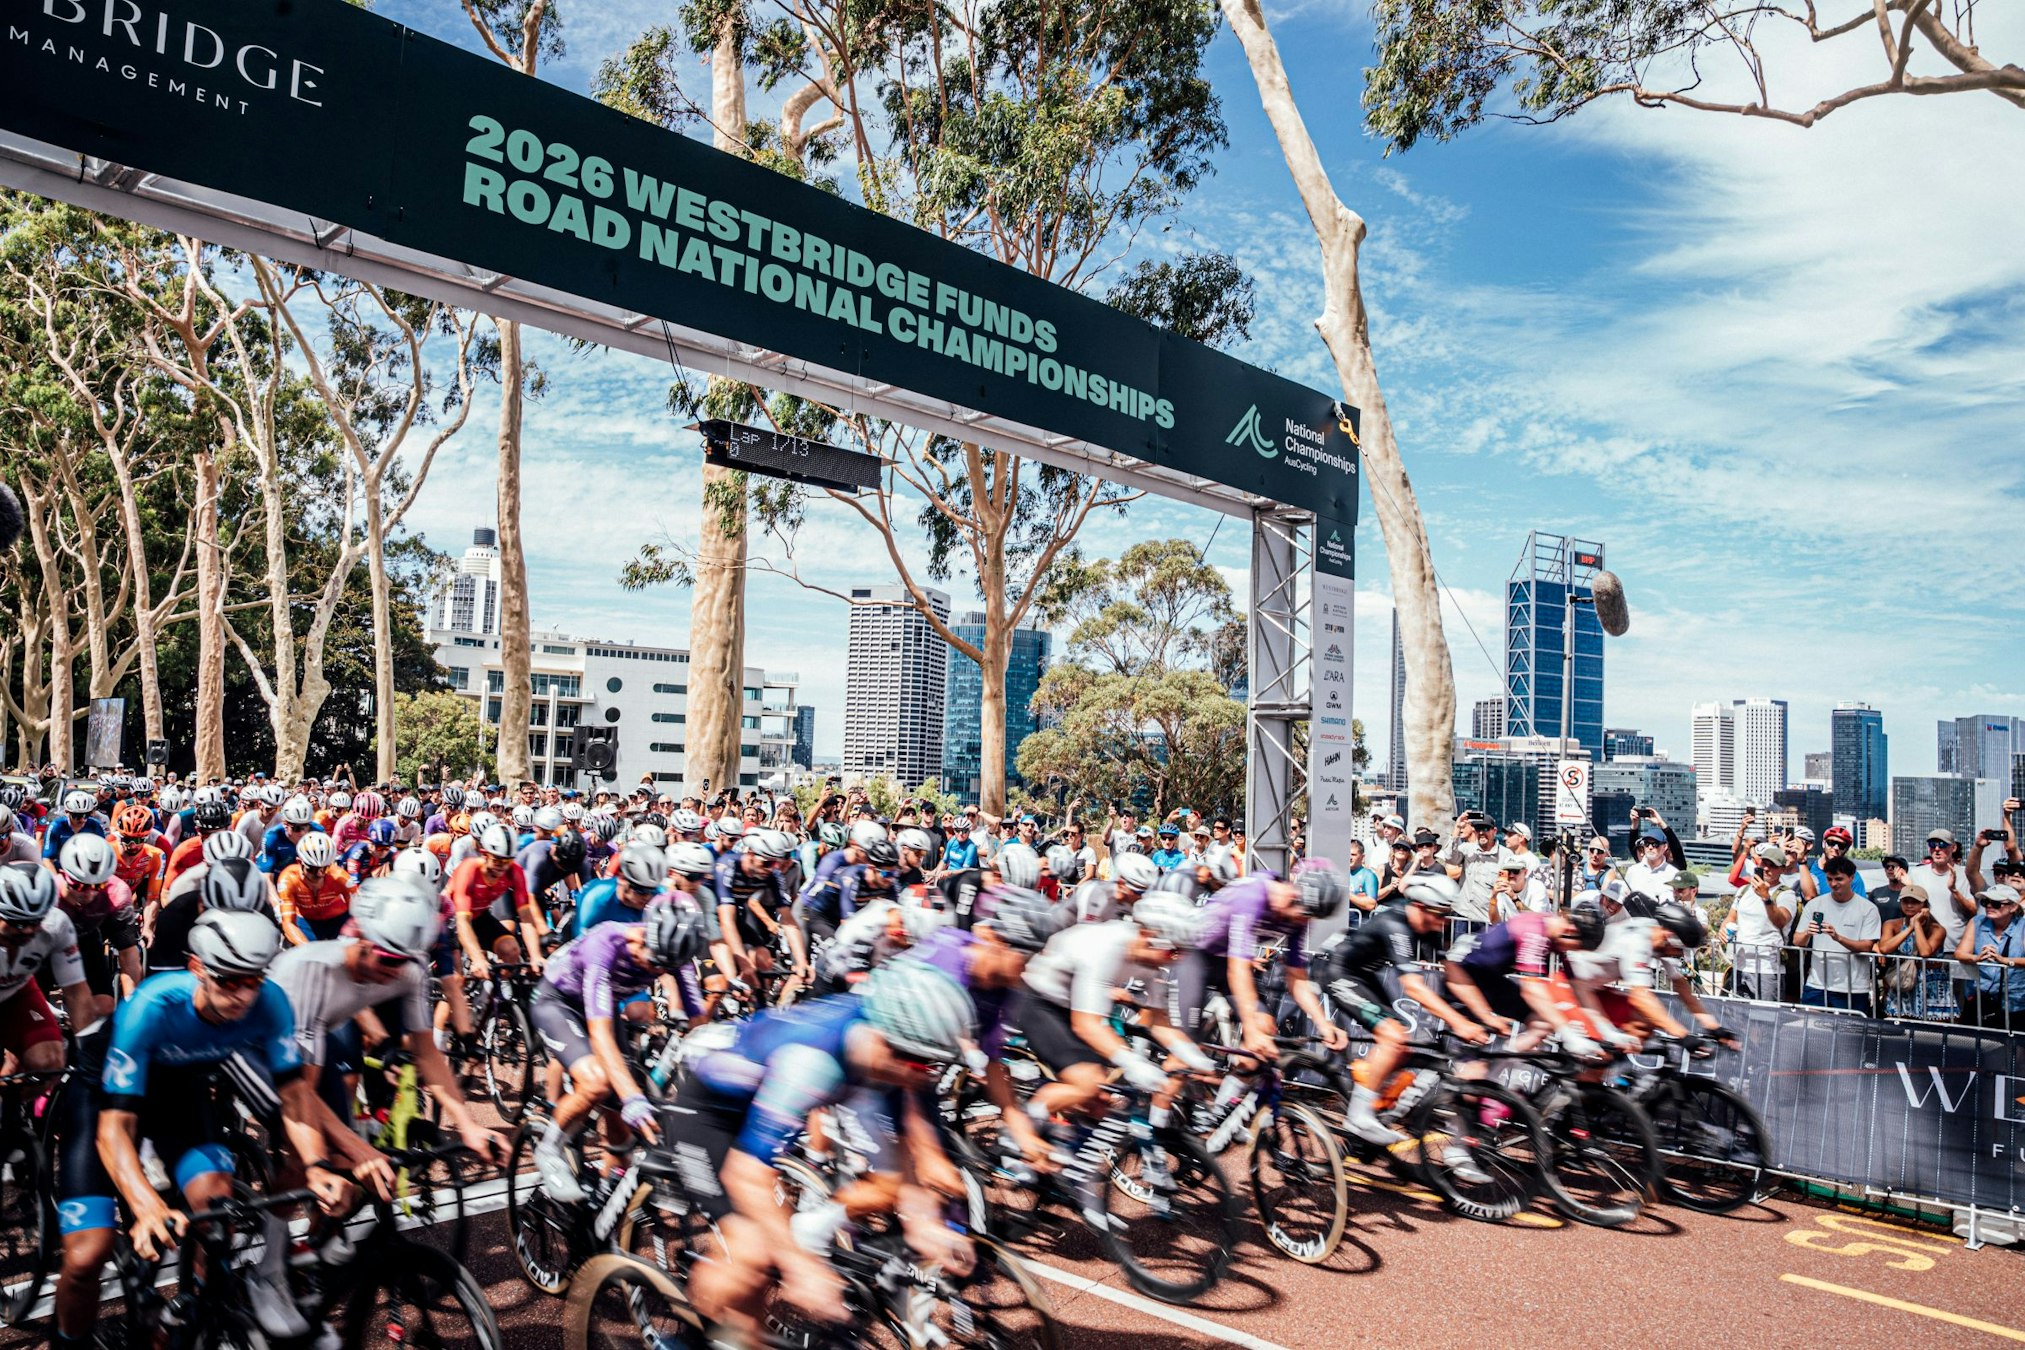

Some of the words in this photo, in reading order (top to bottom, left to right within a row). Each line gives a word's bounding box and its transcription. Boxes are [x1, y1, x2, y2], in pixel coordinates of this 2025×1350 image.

[9, 25, 249, 115] MANAGEMENT
[465, 115, 614, 198] 2026
[623, 167, 930, 310] WESTBRIDGE
[936, 281, 1058, 353] FUNDS
[463, 162, 631, 250] ROAD
[639, 221, 882, 334] NATIONAL
[888, 307, 1175, 429] CHAMPIONSHIPS
[730, 422, 760, 444] Lap
[1285, 418, 1325, 445] National
[1284, 455, 1317, 476] AusCycling
[1285, 436, 1356, 474] Championships
[1321, 717, 1346, 726] SHIMANO
[1325, 751, 1341, 767] HAHN
